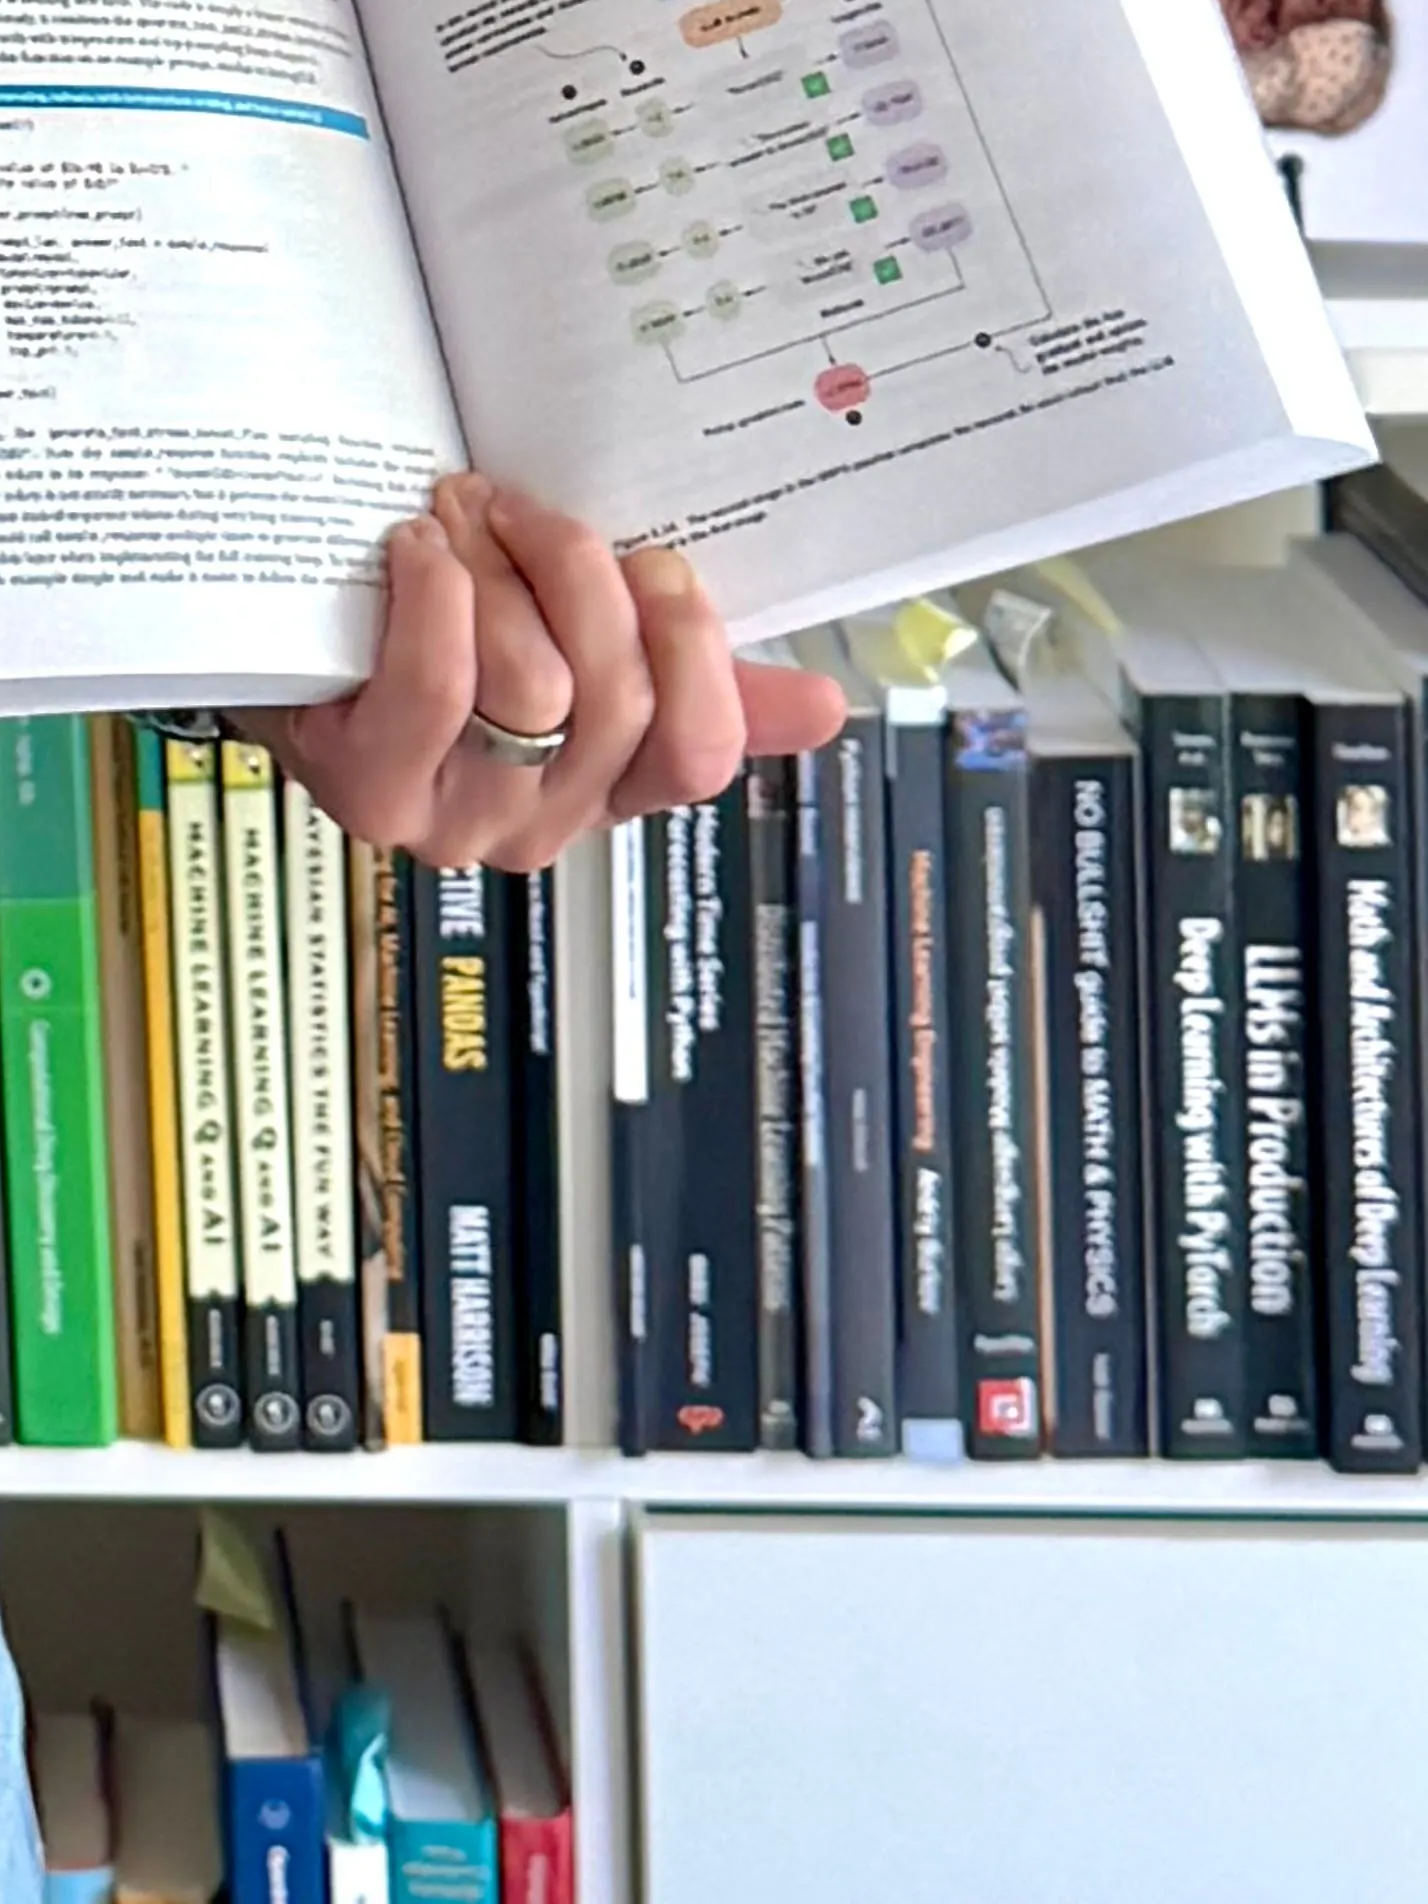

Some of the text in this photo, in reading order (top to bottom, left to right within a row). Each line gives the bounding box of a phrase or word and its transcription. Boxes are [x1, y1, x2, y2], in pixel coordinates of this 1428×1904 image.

[663, 805, 697, 1080] Forecasting with Python
[695, 805, 724, 1030] Modern Time Series
[909, 850, 937, 934] Machine
[185, 821, 228, 1248] MACHINE LEARNING Q AND AI
[242, 827, 284, 1254] MACHINE LEARNING Q AND AI
[306, 933, 333, 1078] STATISTICS
[442, 957, 488, 1072] PANDAS
[907, 937, 938, 1028] Learning
[1072, 780, 1115, 1316] NO BULLSHIT guide to MATH & PHYSICS
[312, 1088, 333, 1133] THE
[312, 1146, 334, 1194] FUN
[909, 1030, 940, 1152] Engineering
[1172, 918, 1230, 1338] Deep Learning with PyTorch
[1243, 945, 1304, 1314] LLMs in Production
[1345, 880, 1401, 1385] Math and Architectures of Deep Learning
[312, 1204, 336, 1261] WAY
[911, 1168, 943, 1234] Andriy
[449, 1204, 494, 1407] MATT HARRISON
